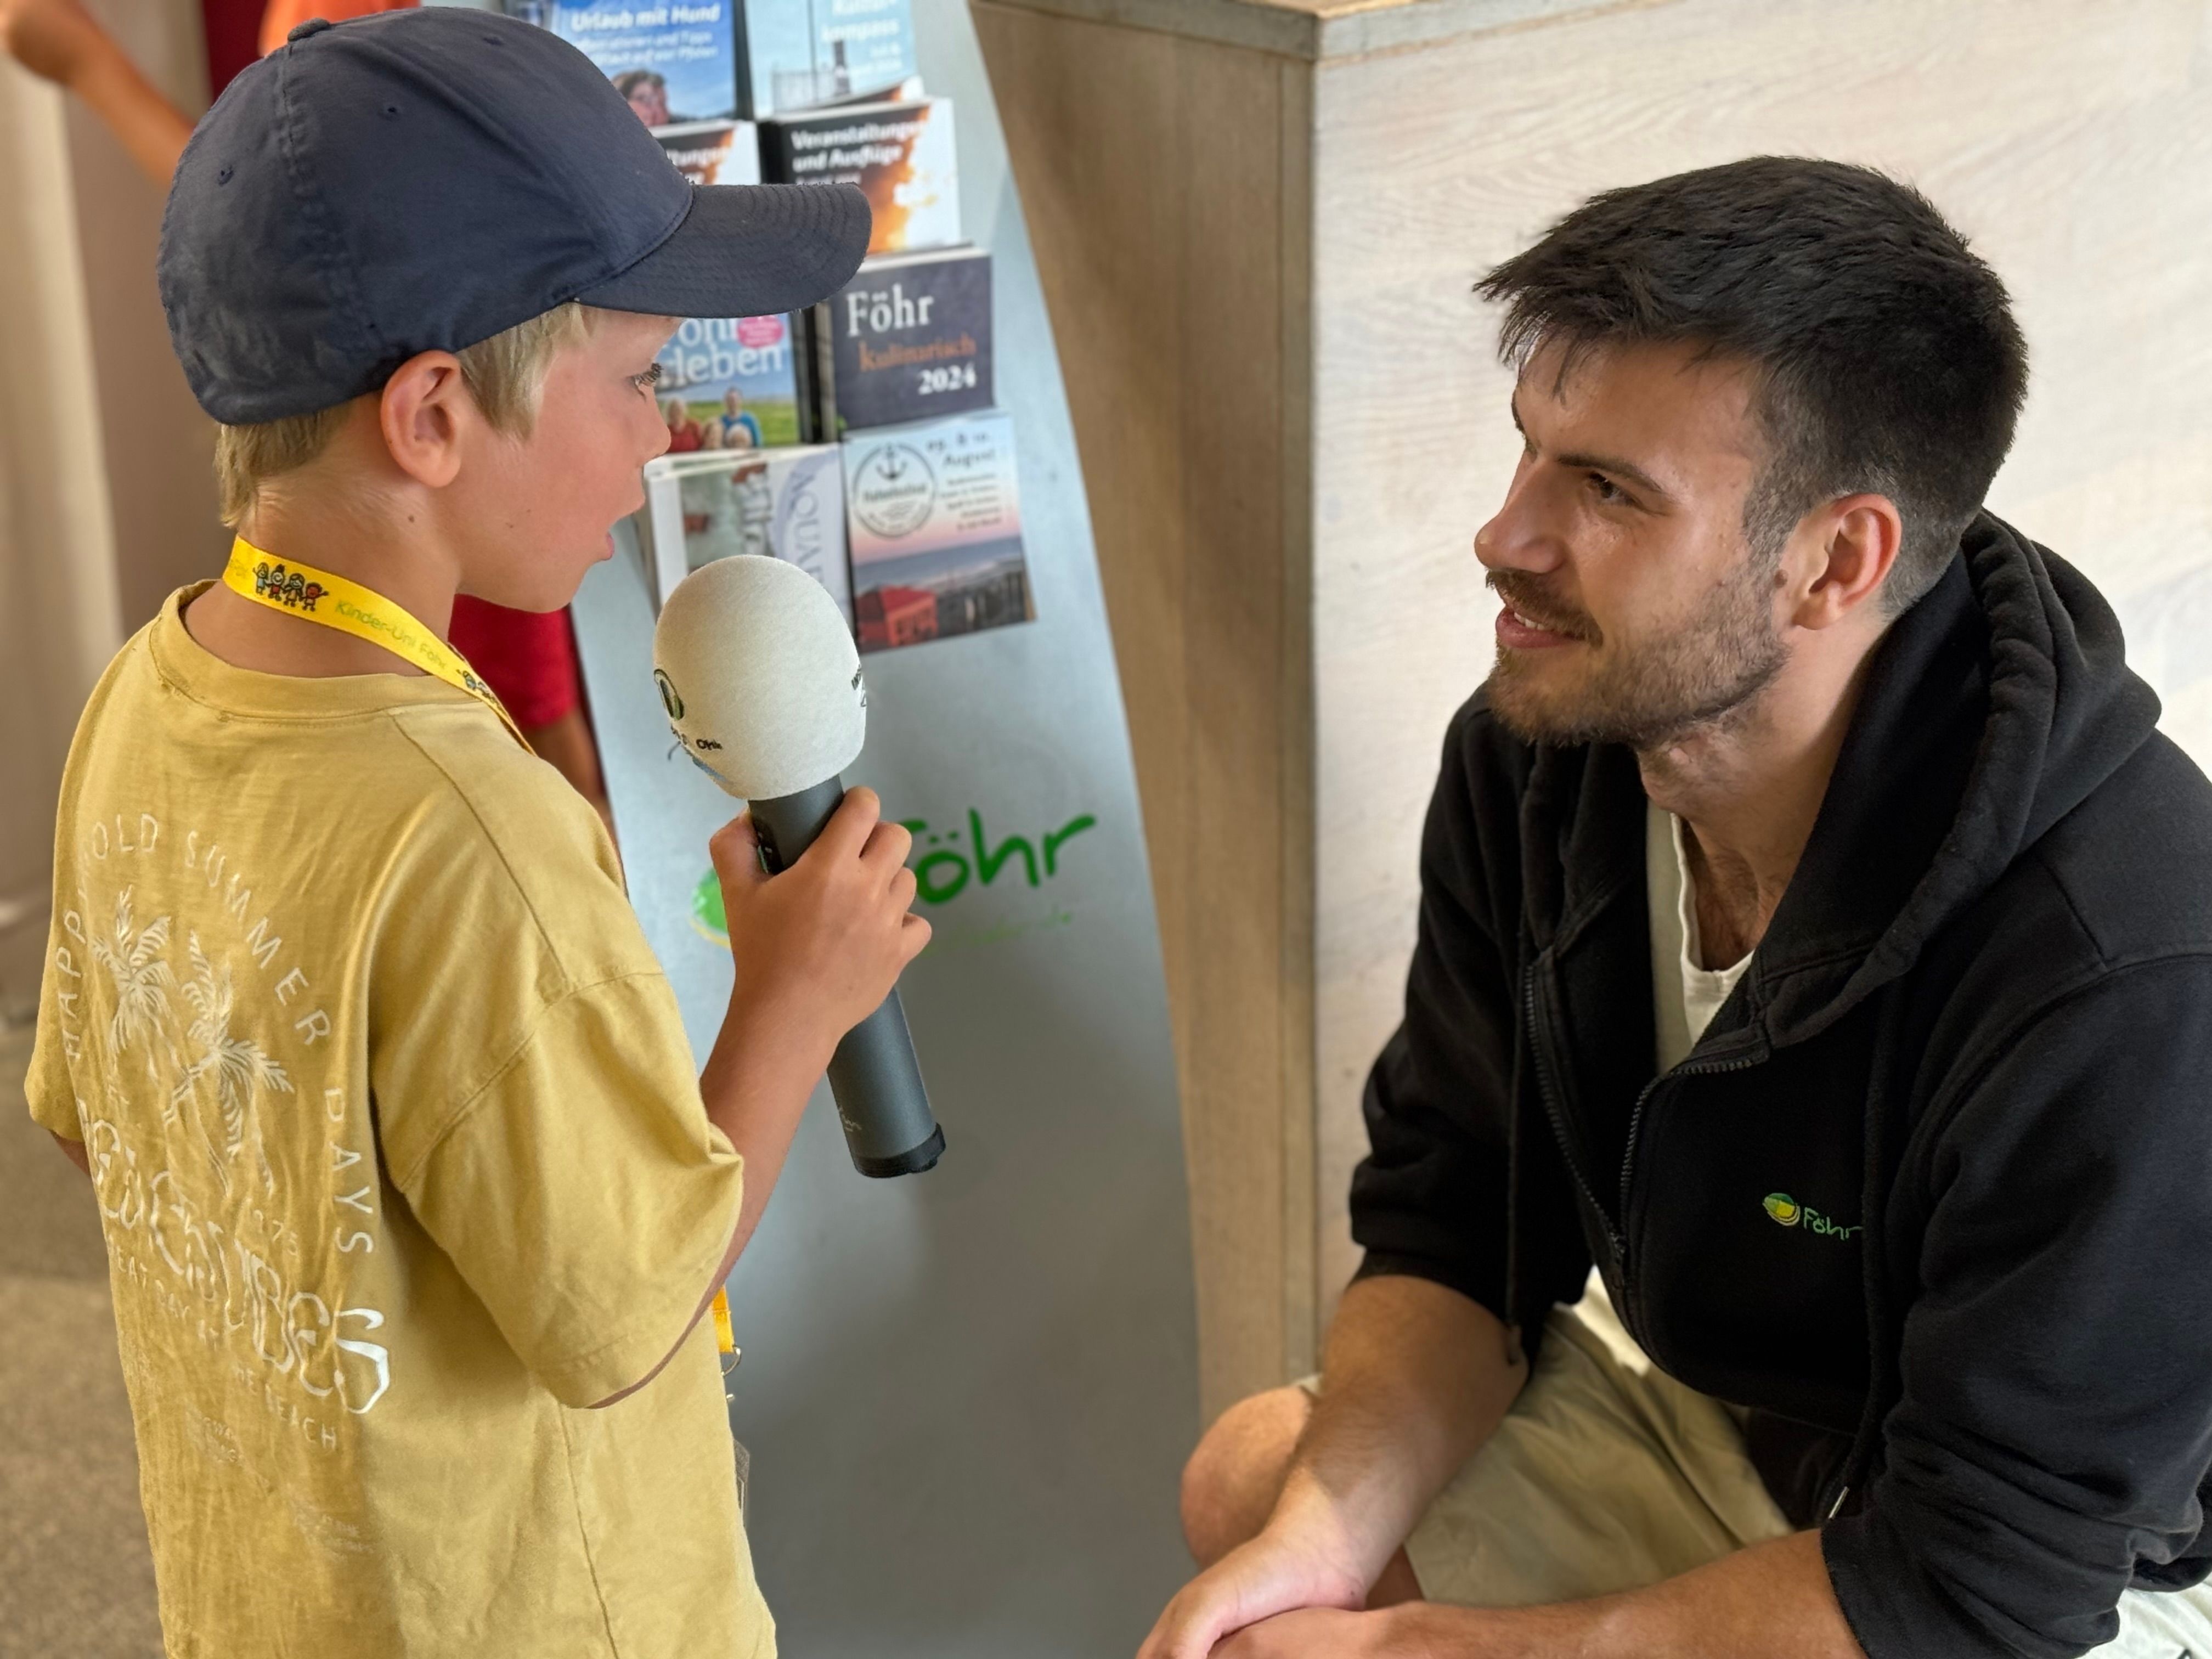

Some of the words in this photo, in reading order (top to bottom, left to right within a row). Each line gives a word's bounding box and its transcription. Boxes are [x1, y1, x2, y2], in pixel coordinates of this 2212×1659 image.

[572, 10, 633, 31] Urlaub
[636, 8, 668, 26] mit
[671, 4, 720, 24] Hund
[793, 150, 827, 172] und
[828, 144, 903, 169] Ausflüge
[847, 283, 935, 337] Föhr
[658, 343, 783, 387] rleben
[858, 331, 977, 373] kulinarisch
[917, 361, 977, 395] 2024
[93, 813, 159, 860] OLD
[185, 831, 331, 1045] SUMMER
[325, 1087, 374, 1253] DAYS
[1803, 1206, 1864, 1241] Föhr
